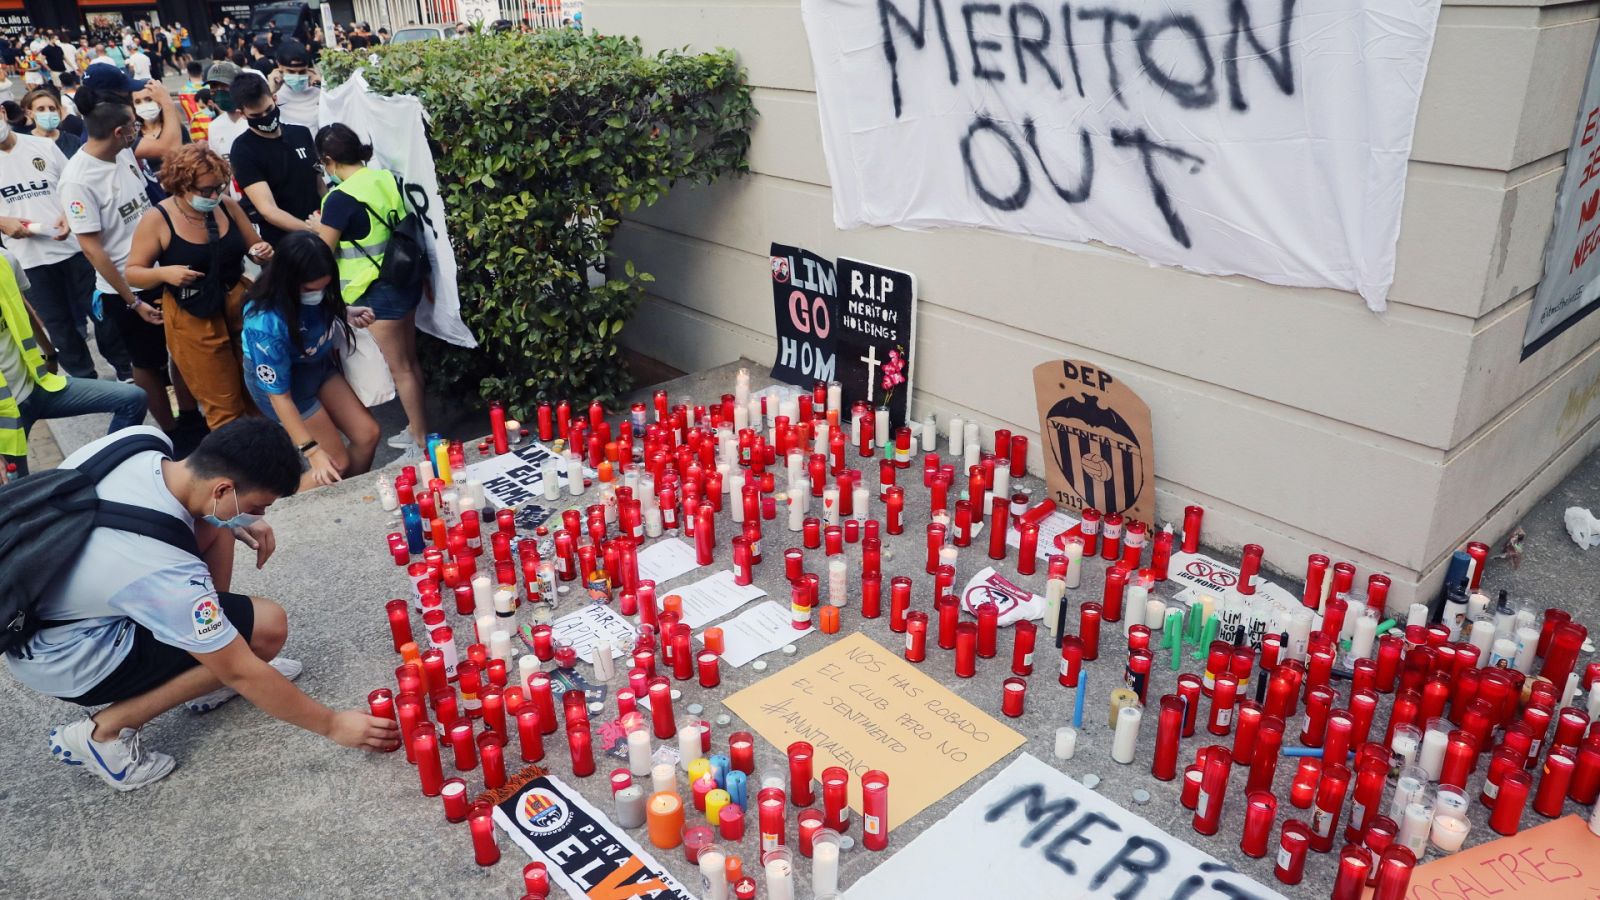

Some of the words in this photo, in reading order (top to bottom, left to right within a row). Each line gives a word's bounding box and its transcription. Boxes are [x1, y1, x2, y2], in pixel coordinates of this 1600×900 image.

[878, 0, 1295, 118] MERITON
[960, 113, 1205, 249] OUT
[788, 255, 837, 298] LIM
[788, 290, 830, 339] GO
[1050, 421, 1111, 446] VALENCIA
[482, 476, 537, 507] HOME
[505, 464, 543, 486] GO
[1055, 490, 1083, 511] 1919
[198, 621, 223, 635] LaLiga
[791, 677, 815, 696] EL
[822, 695, 908, 754] SENTIMIENTO
[817, 662, 841, 684] EL
[847, 682, 888, 711] CLUB
[895, 711, 933, 742] PERO
[936, 739, 969, 764] NO
[845, 646, 887, 674] NOS
[887, 673, 925, 699] HAS
[923, 699, 991, 744] ROBADO
[544, 833, 606, 892] EL
[579, 823, 631, 868] PEÑA
